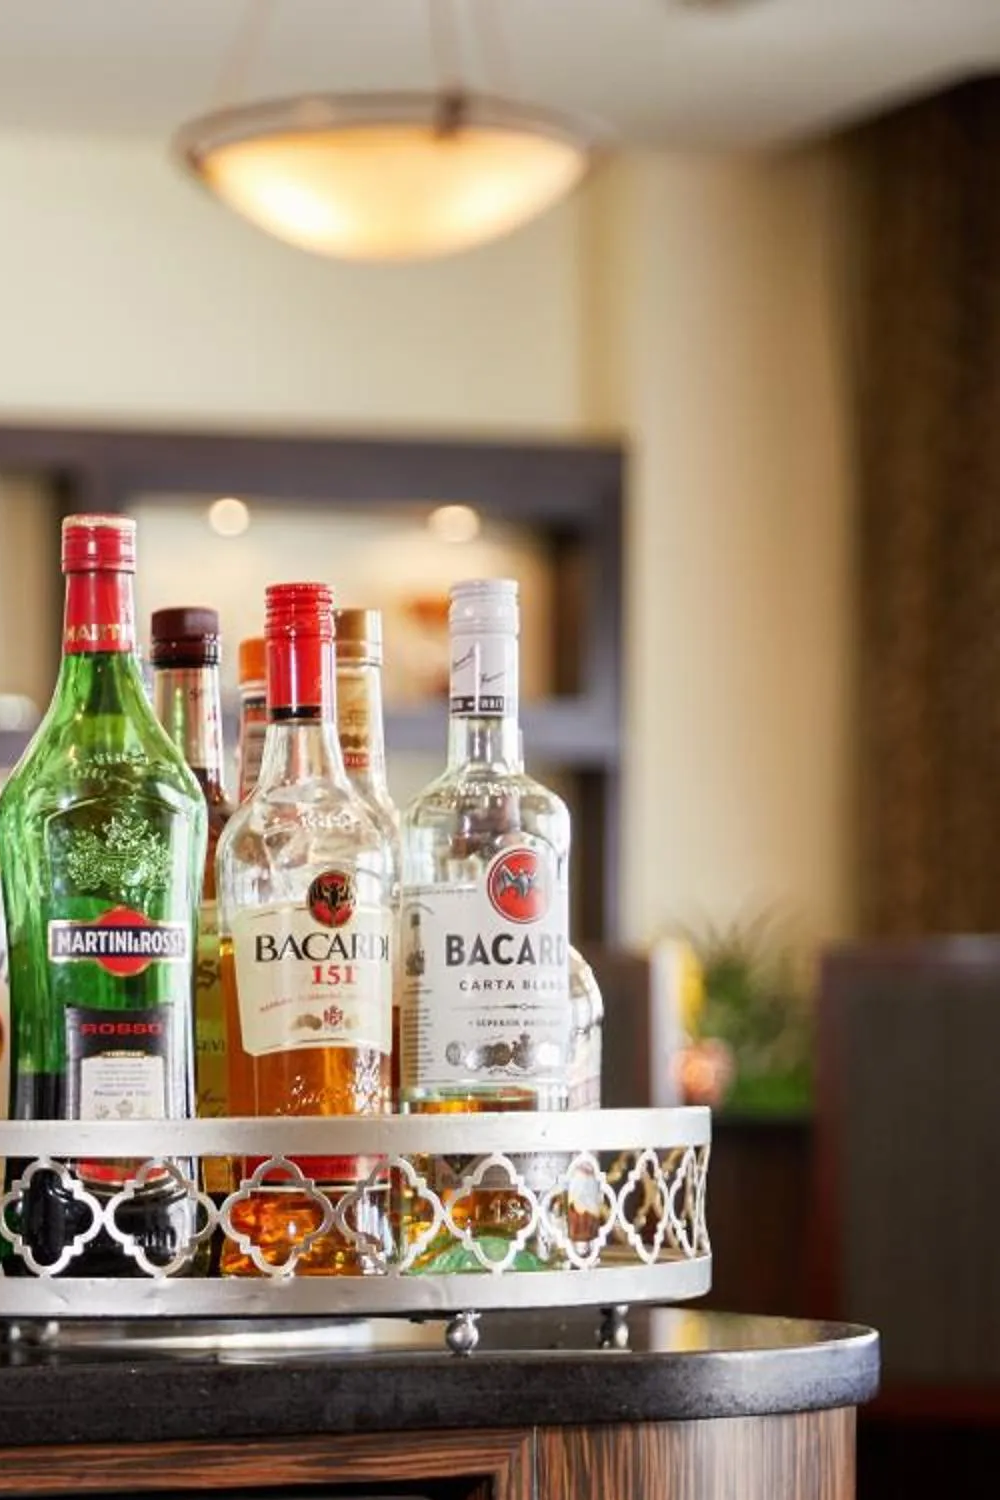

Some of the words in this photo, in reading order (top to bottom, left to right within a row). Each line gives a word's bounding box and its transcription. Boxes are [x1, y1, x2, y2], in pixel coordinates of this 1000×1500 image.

[255, 933, 389, 962] BACARDI
[311, 965, 356, 985] 151
[459, 980, 515, 991] CARTA
[80, 1023, 164, 1037] ROSSO
